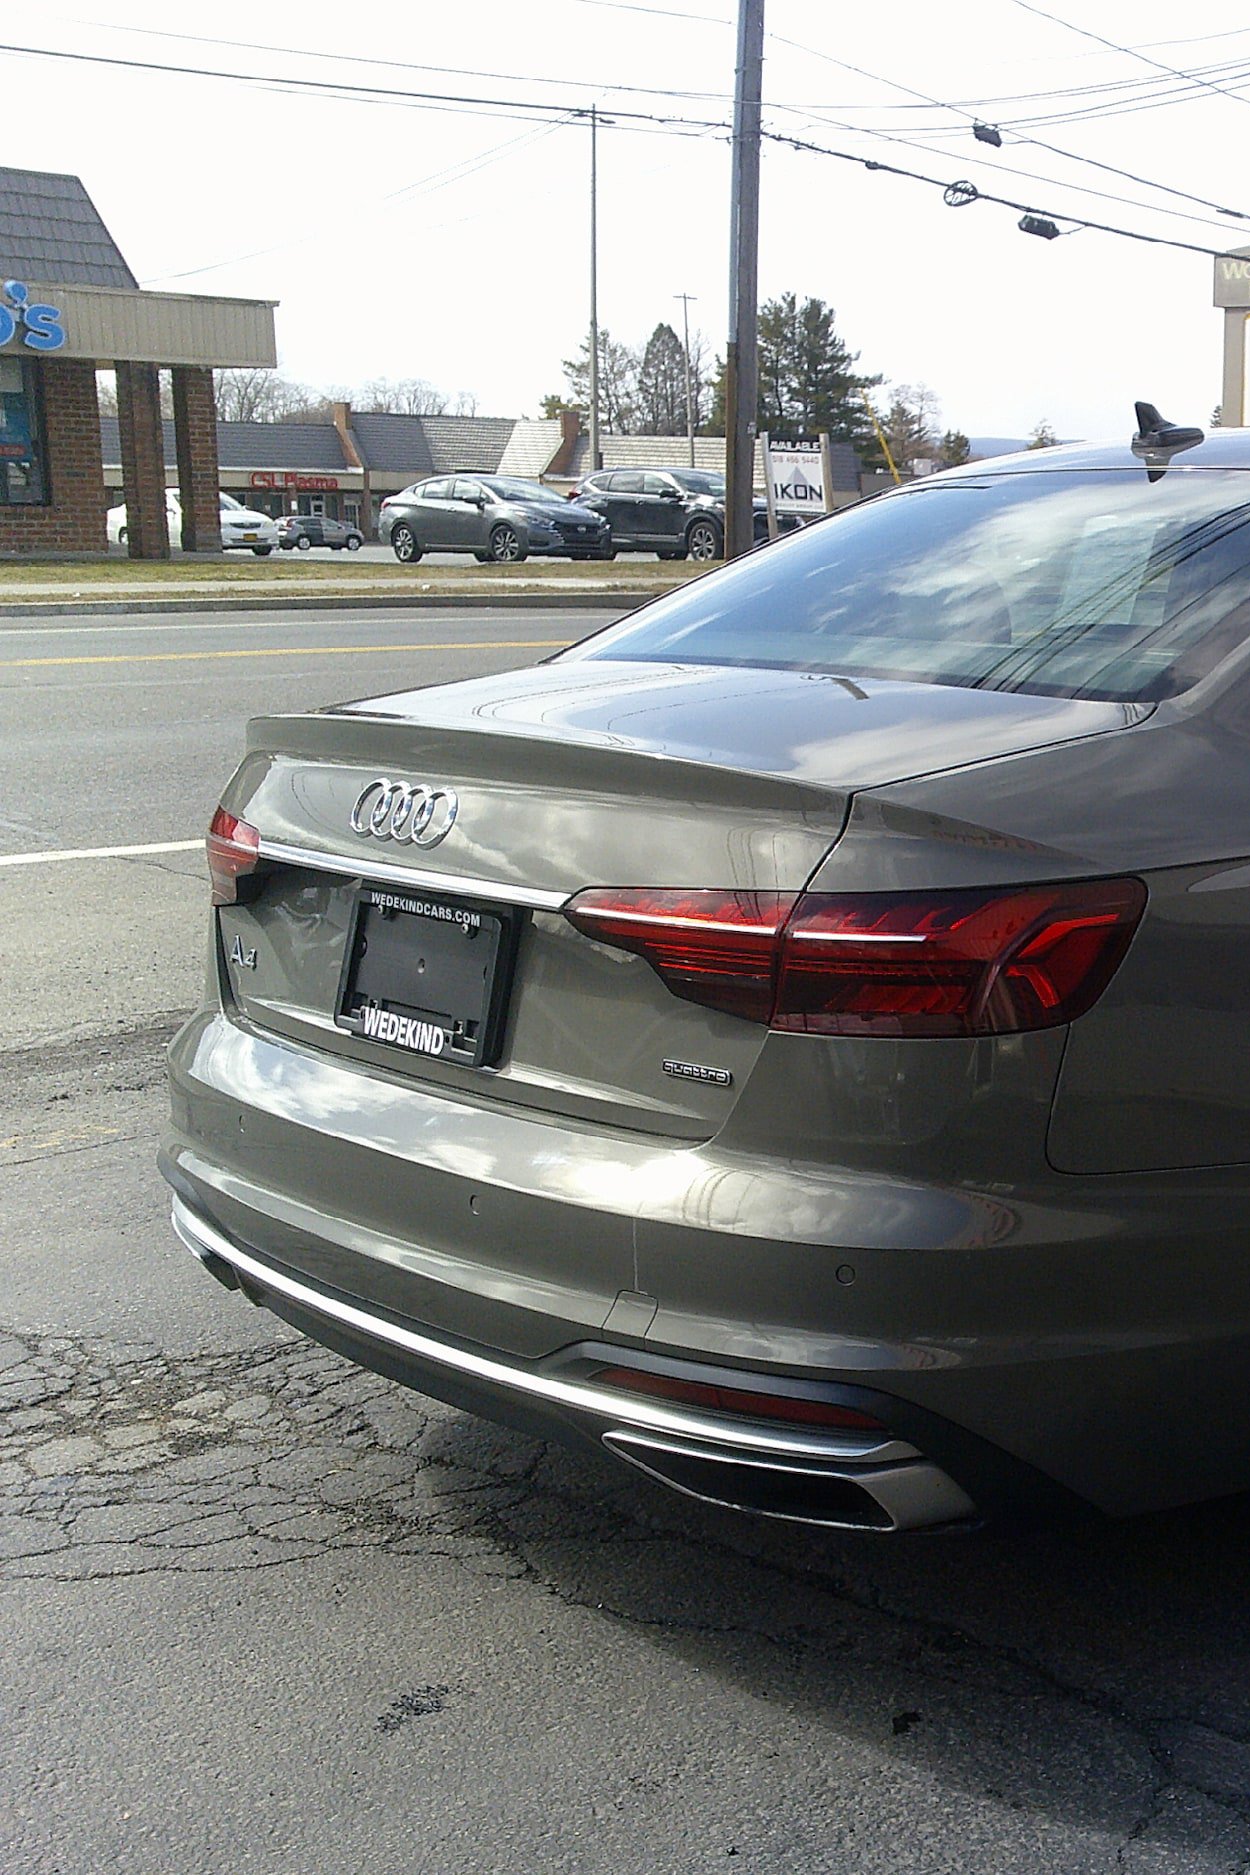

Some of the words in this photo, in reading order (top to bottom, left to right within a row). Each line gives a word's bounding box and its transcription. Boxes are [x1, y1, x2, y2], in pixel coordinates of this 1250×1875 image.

[0, 280, 66, 351] 's
[769, 440, 820, 452] AVAILABLE
[252, 472, 285, 488] CSL
[285, 472, 338, 489] Plasma
[774, 483, 823, 501] IKON
[371, 891, 481, 928] WEDEKINDCARS.COM
[230, 934, 256, 970] A4
[363, 1006, 445, 1055] WEDEKIND
[663, 1061, 727, 1082] quattro
